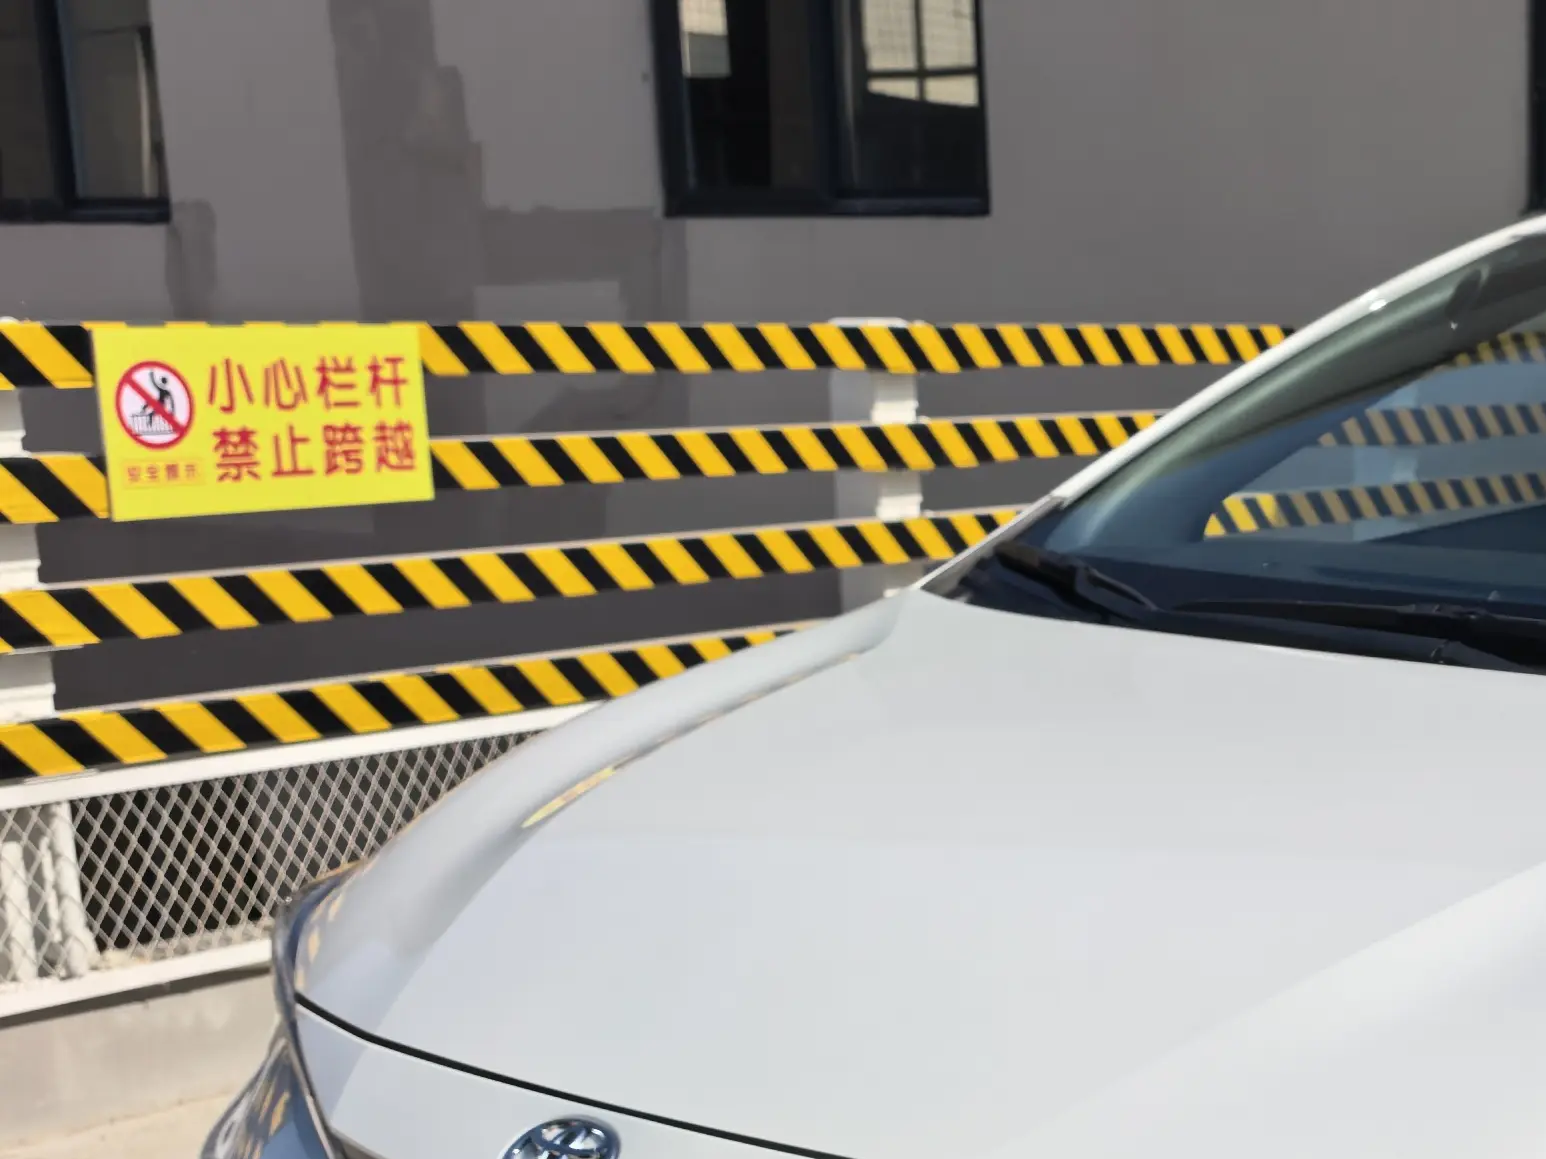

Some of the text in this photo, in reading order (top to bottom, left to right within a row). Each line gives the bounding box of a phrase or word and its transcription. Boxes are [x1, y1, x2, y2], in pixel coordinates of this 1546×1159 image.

[208, 355, 408, 413] 小心栏杆
[212, 420, 416, 482] 禁止跨越
